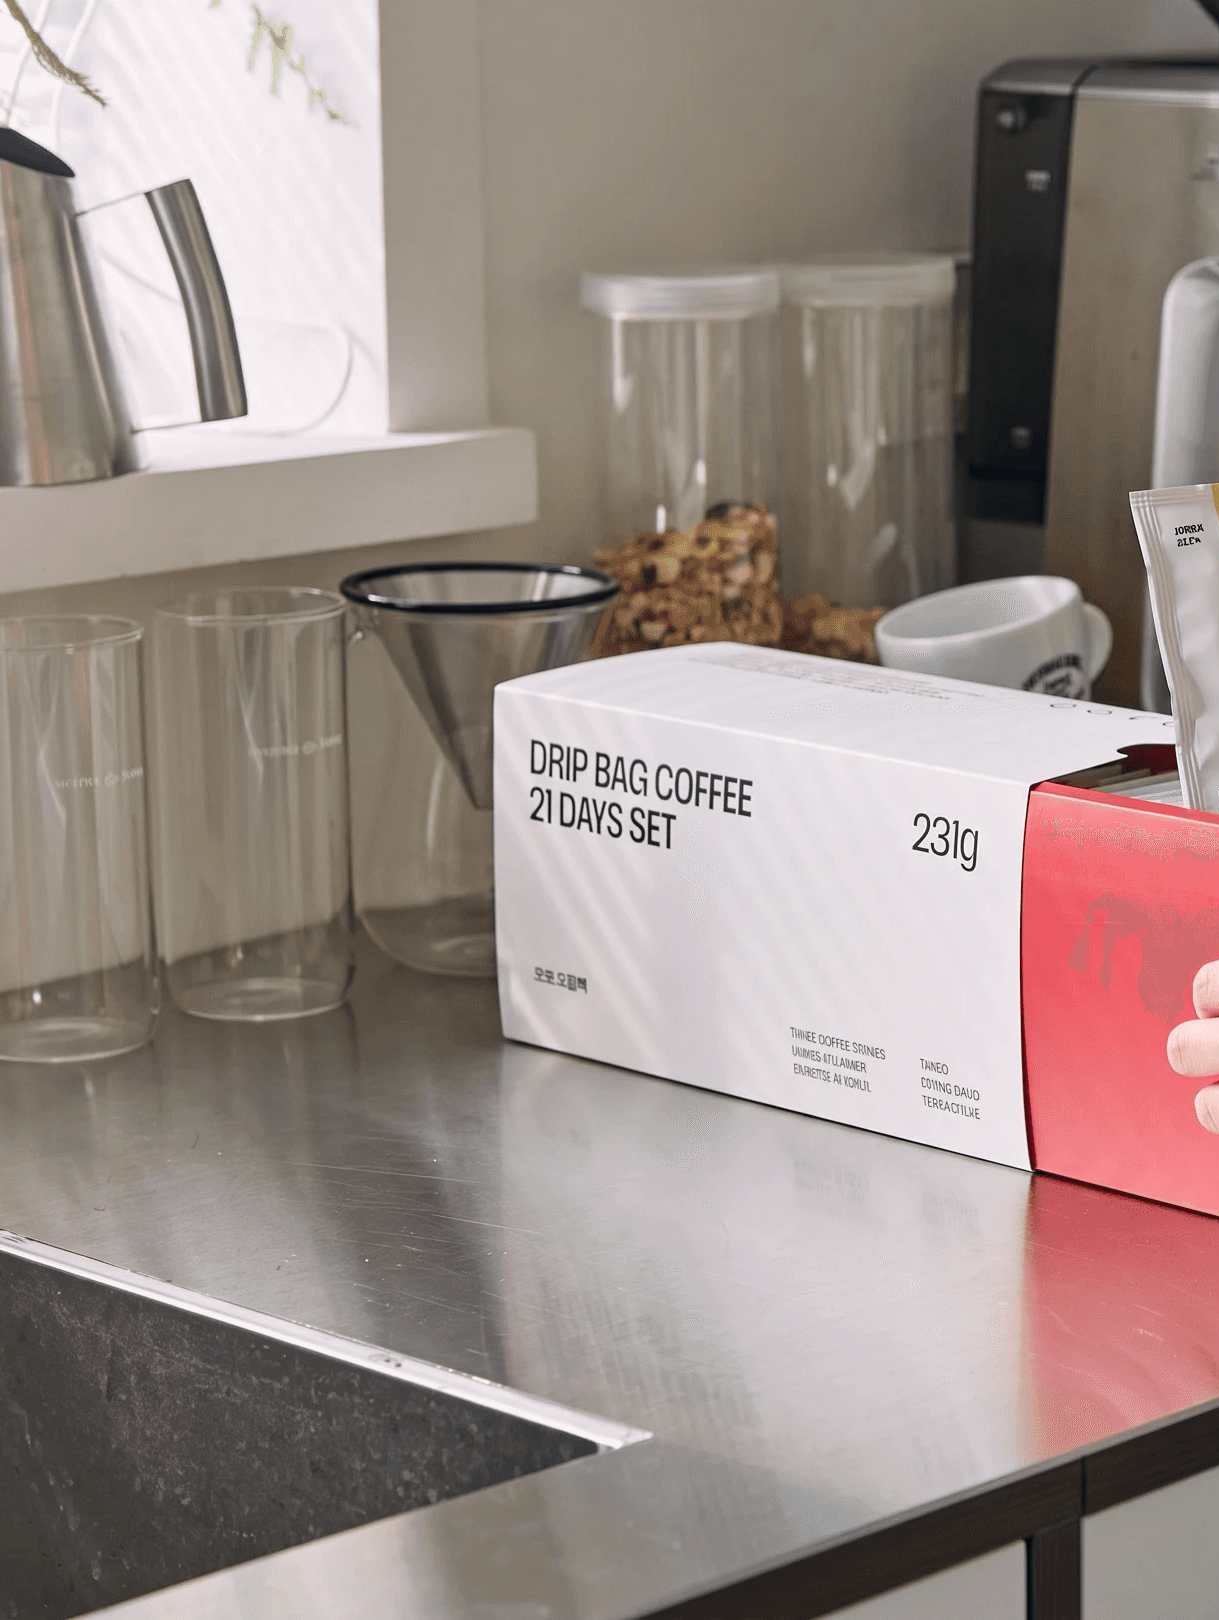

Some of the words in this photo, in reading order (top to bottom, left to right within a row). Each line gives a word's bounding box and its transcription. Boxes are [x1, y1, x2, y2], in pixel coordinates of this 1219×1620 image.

[530, 739, 588, 783] DRIP
[595, 751, 648, 797] BAG
[655, 763, 753, 818] COFFEE
[530, 786, 552, 825] 21
[559, 791, 623, 839] DAYS
[629, 806, 677, 850] SET
[912, 812, 979, 873] 231g
